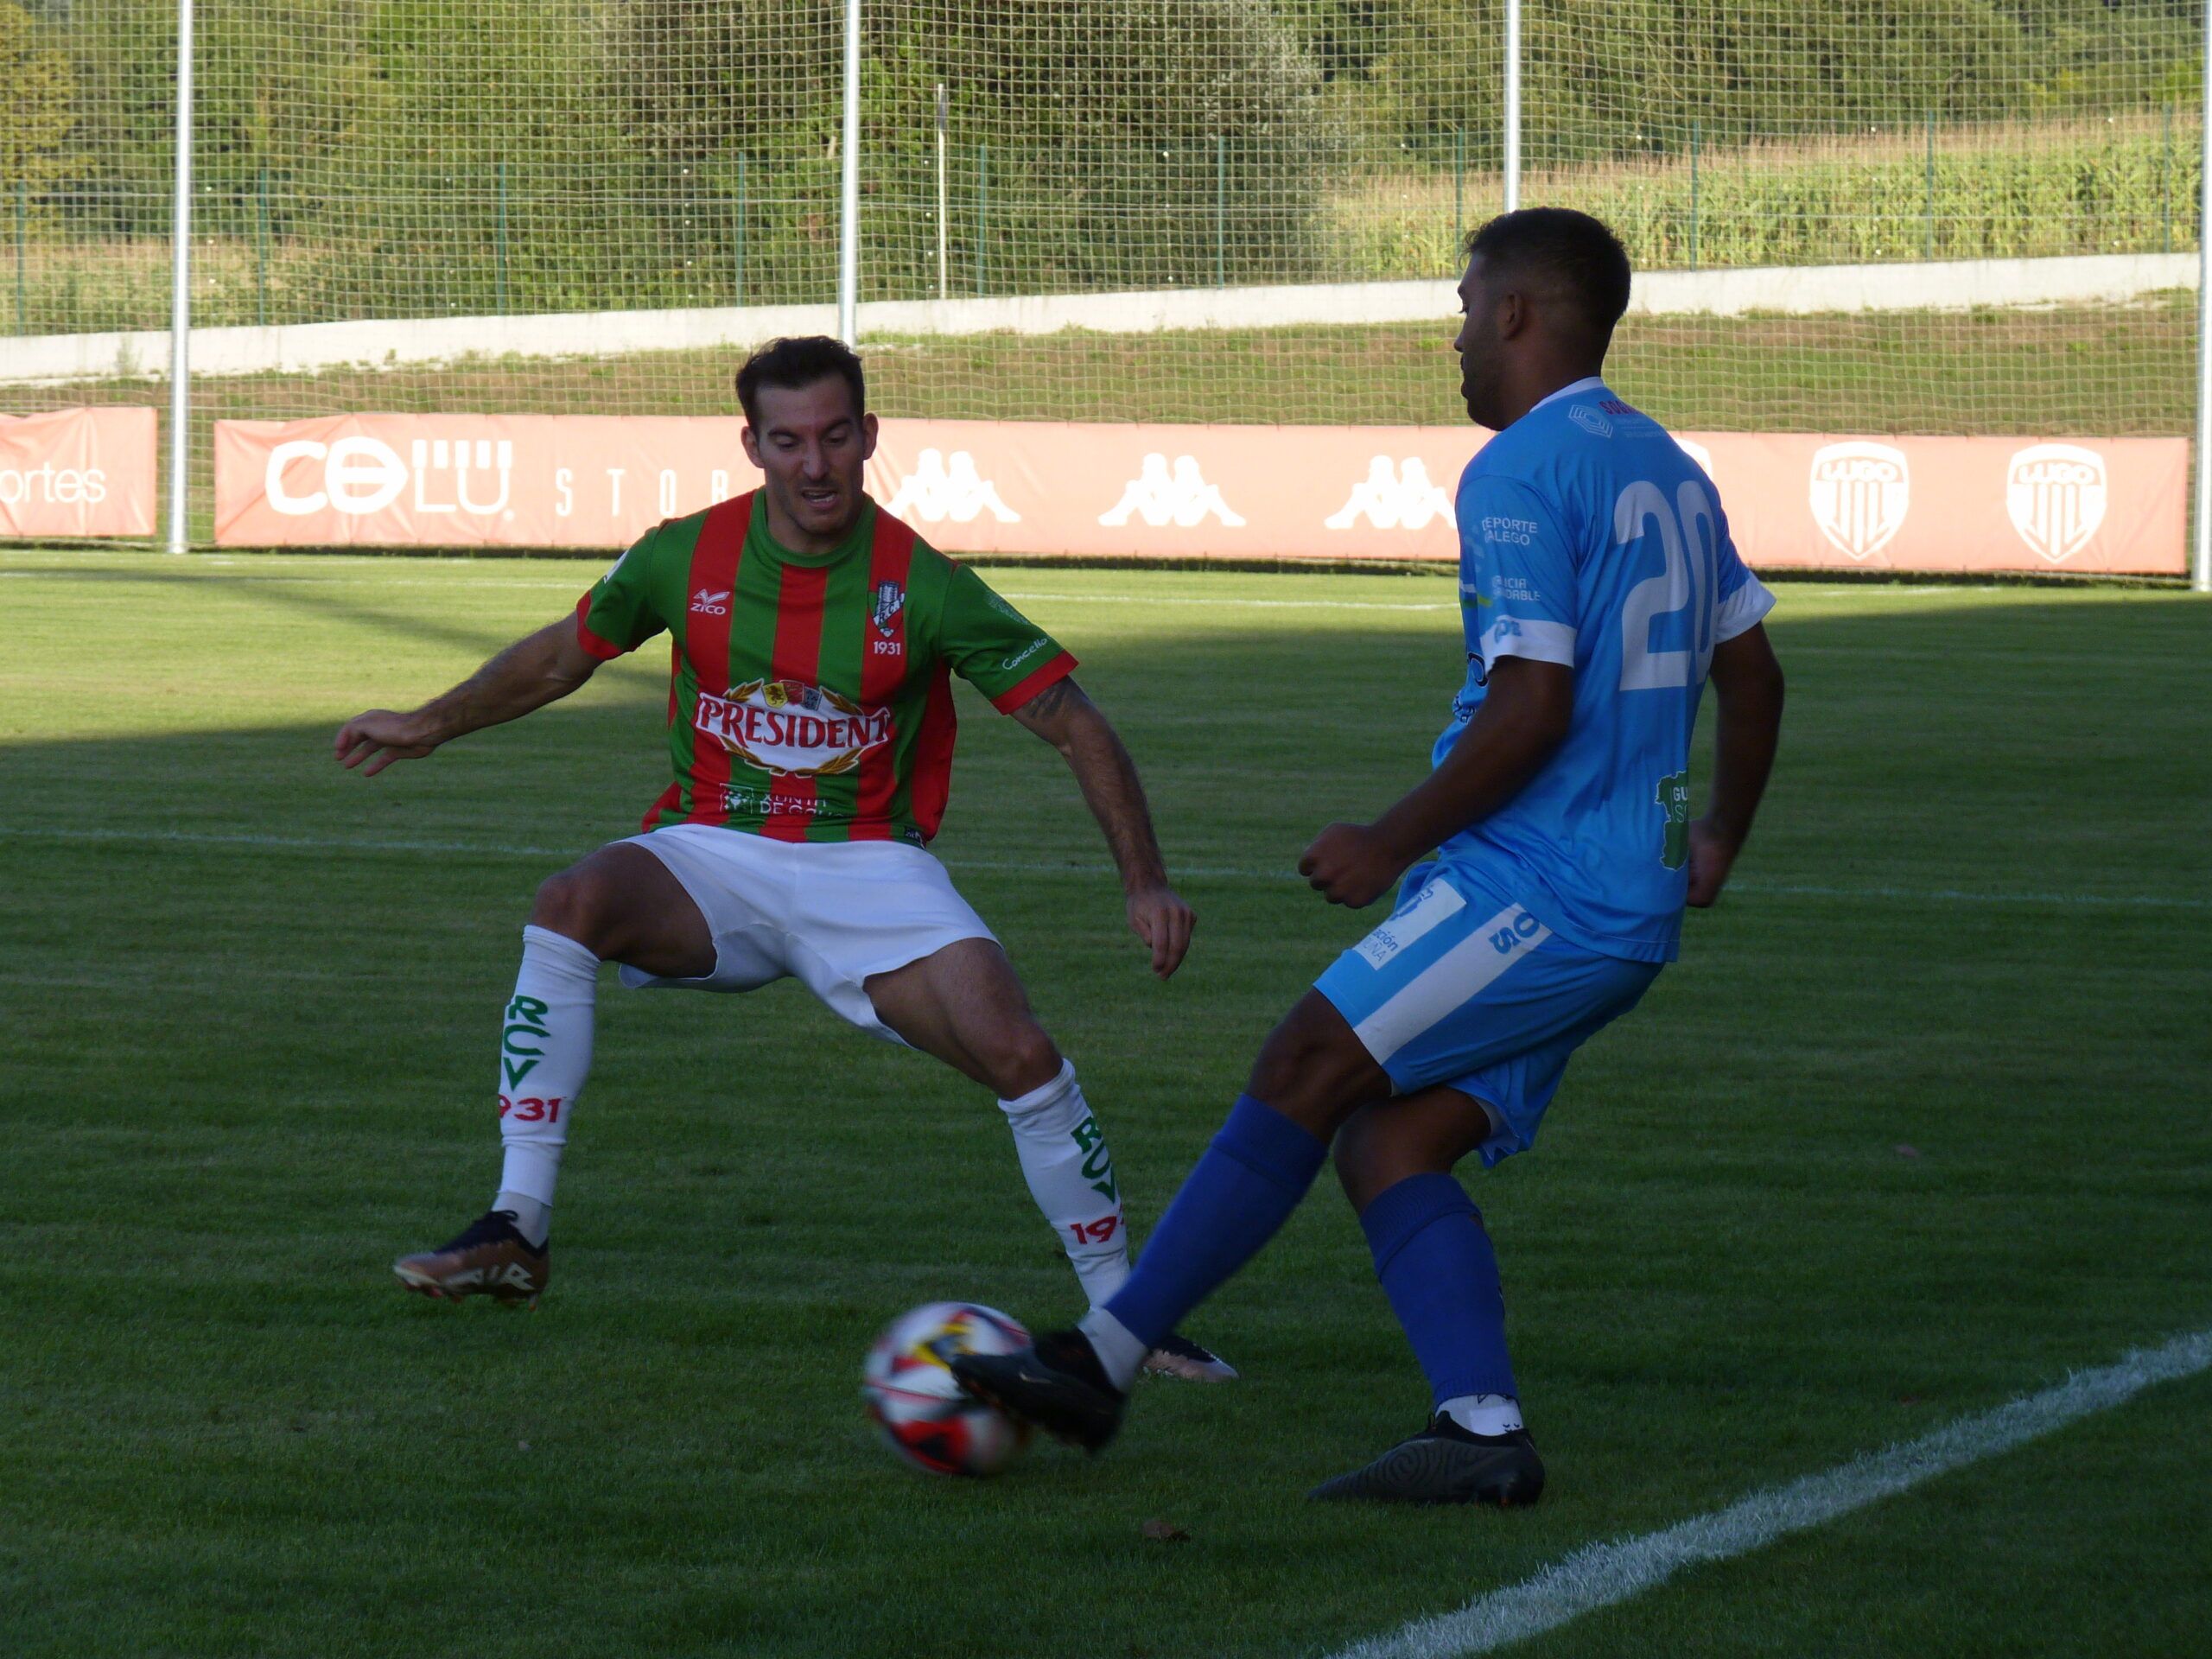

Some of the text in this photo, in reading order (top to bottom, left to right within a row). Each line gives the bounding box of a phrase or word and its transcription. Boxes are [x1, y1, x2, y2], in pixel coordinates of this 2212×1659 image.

[0, 461, 106, 504] ortes
[1614, 480, 1719, 691] 20
[873, 641, 901, 655] 1931
[1001, 637, 1048, 670] Concello
[700, 696, 891, 748] PRESIDENT
[1070, 1210, 1122, 1245] 19
